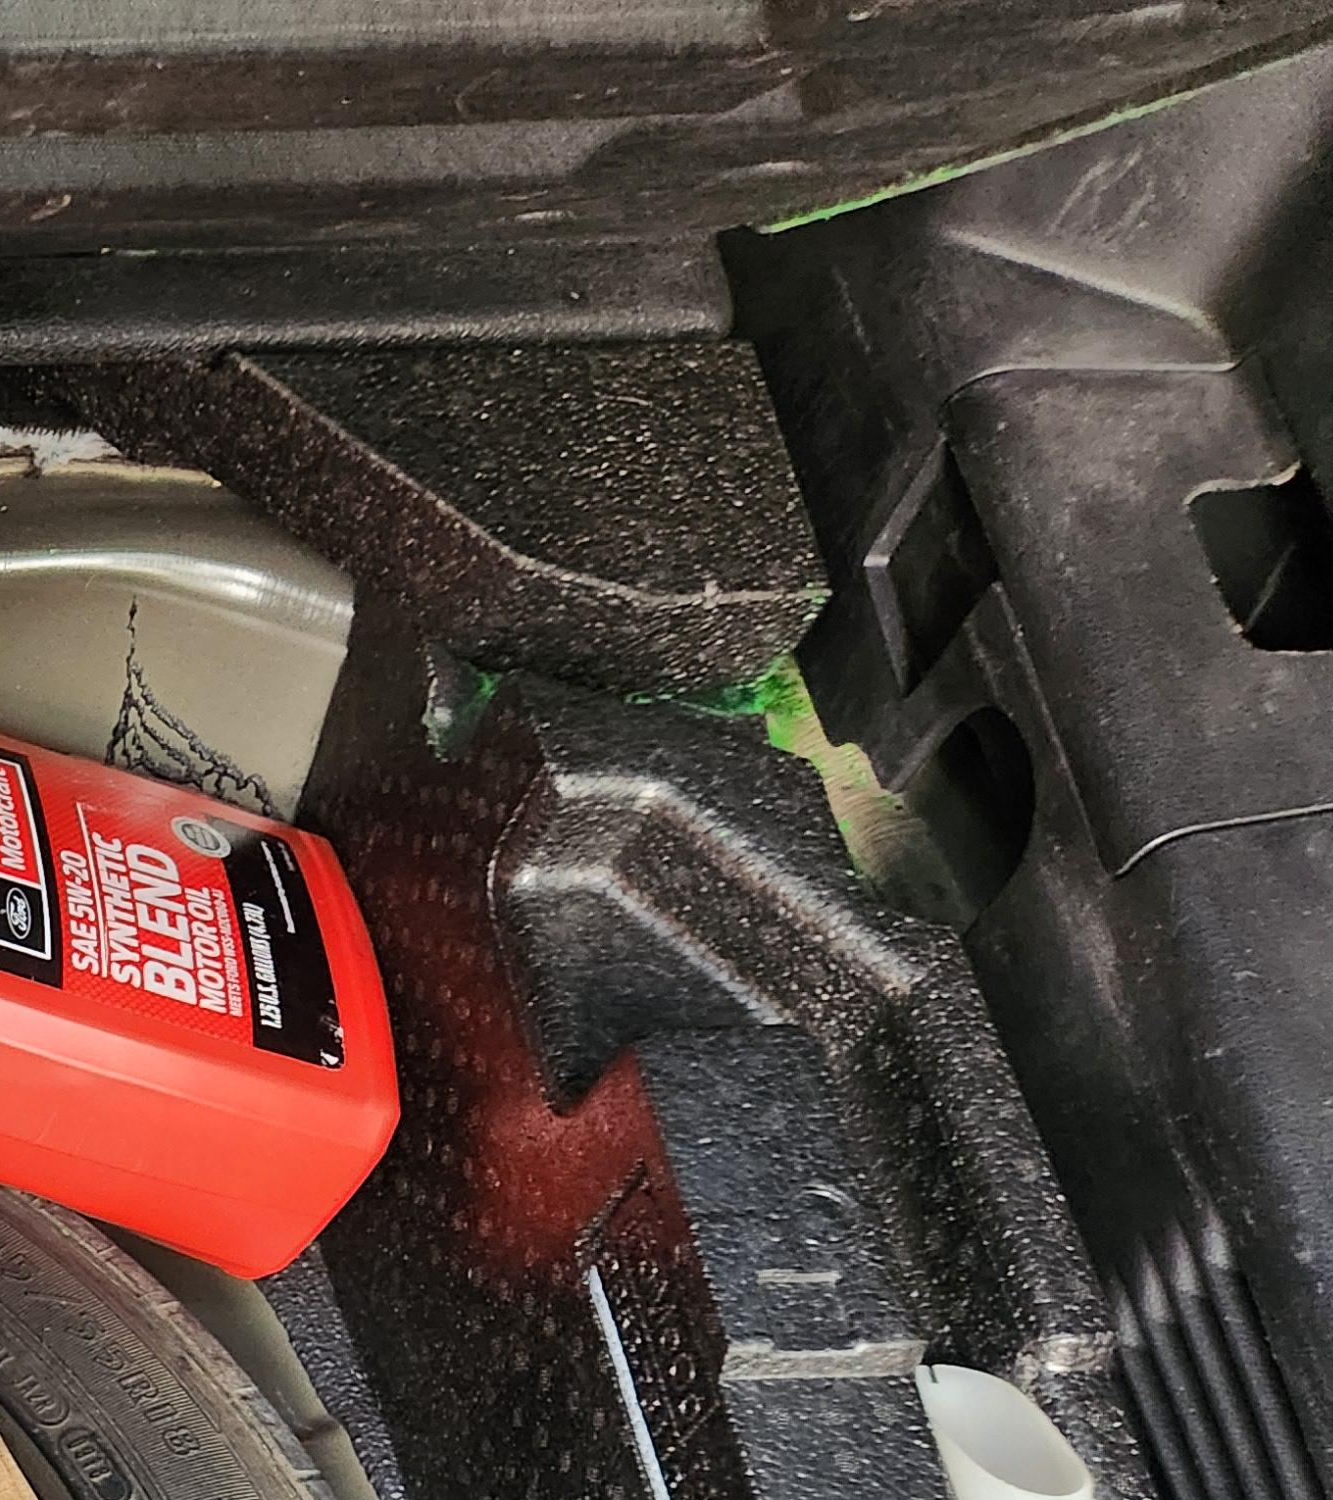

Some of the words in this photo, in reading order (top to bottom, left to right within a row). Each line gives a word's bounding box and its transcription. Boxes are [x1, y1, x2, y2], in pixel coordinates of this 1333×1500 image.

[60, 849, 96, 921] 5W-20
[91, 831, 142, 989] SYNTHETIC
[184, 886, 216, 922] OIL
[70, 921, 100, 975] SAE
[125, 843, 198, 1006] BLEND
[191, 919, 228, 1014] MOTOR
[222, 957, 239, 984] FORD
[250, 937, 278, 985] GALLONS
[226, 982, 244, 1018] MEETS
[259, 1004, 283, 1029] 1.25
